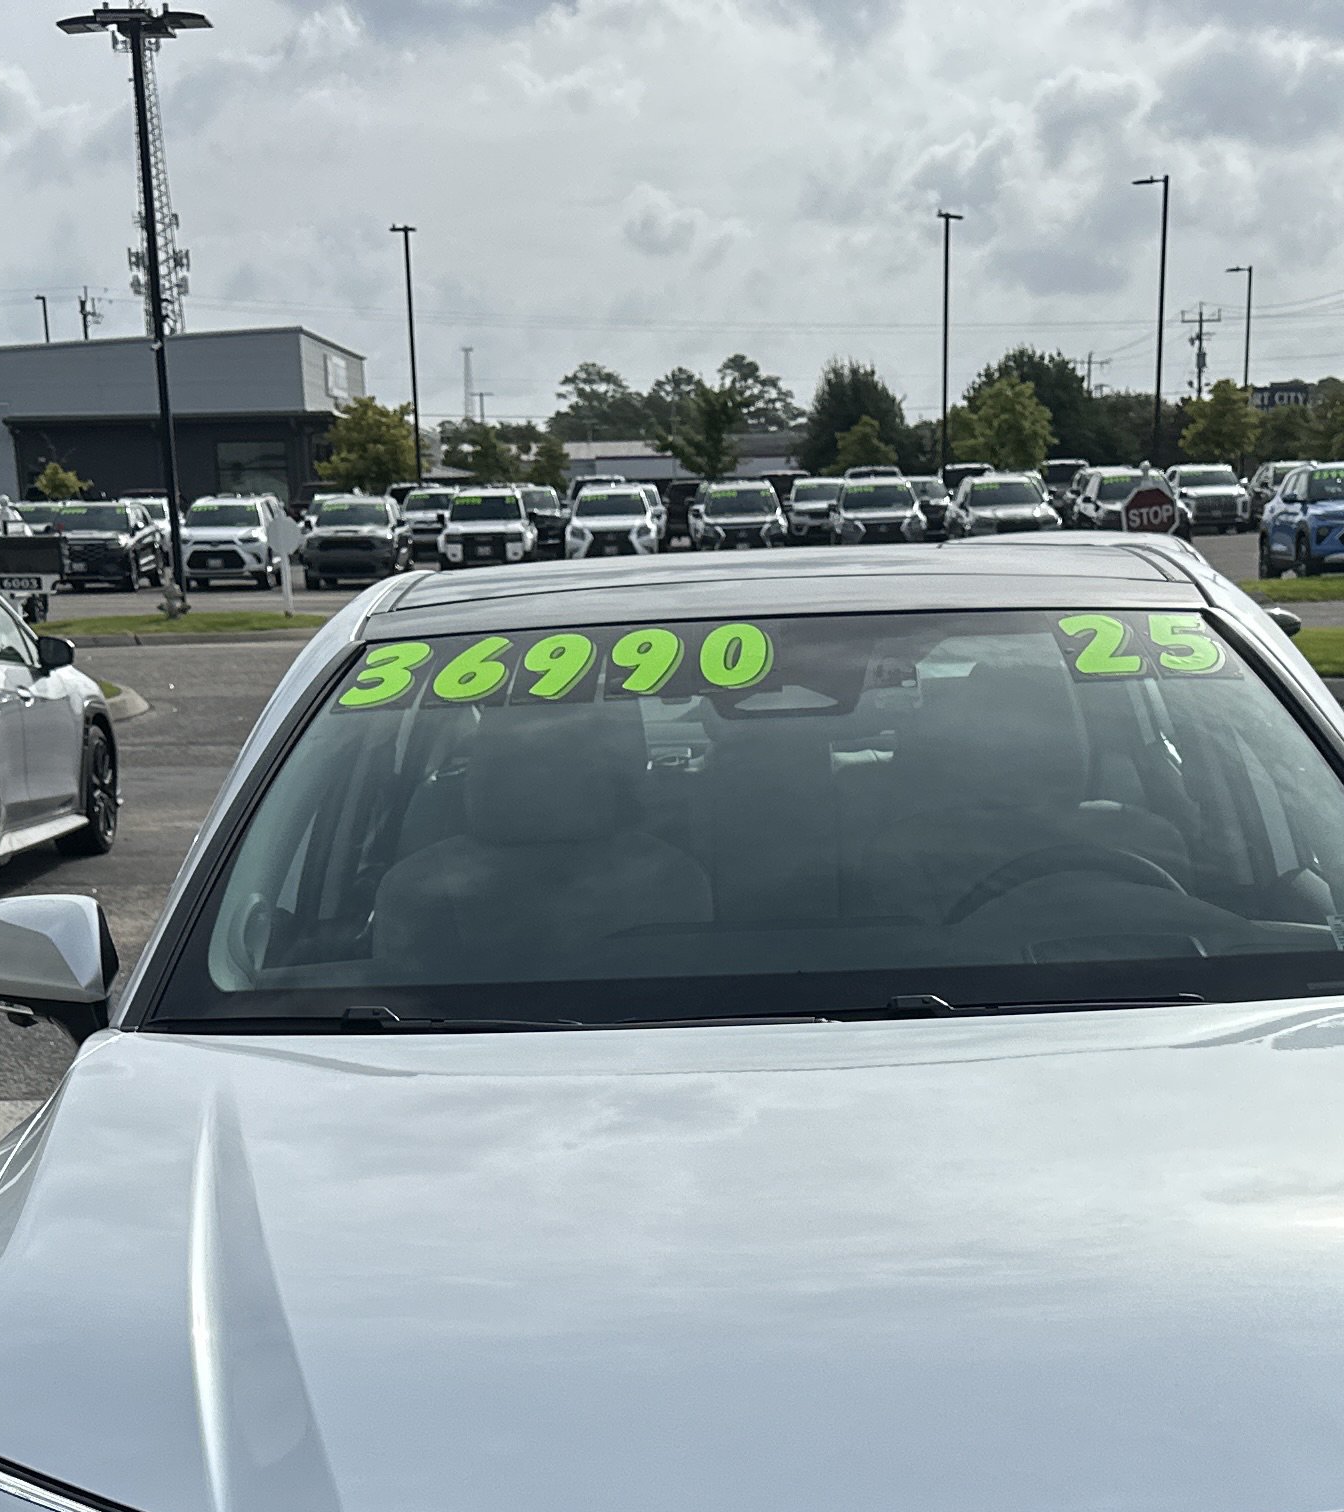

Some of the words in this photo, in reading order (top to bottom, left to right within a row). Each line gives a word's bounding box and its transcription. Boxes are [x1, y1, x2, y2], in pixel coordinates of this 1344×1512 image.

[1128, 504, 1173, 528] STOP
[2, 578, 39, 590] 6003
[338, 623, 774, 708] 36990
[1058, 613, 1227, 675] 25
